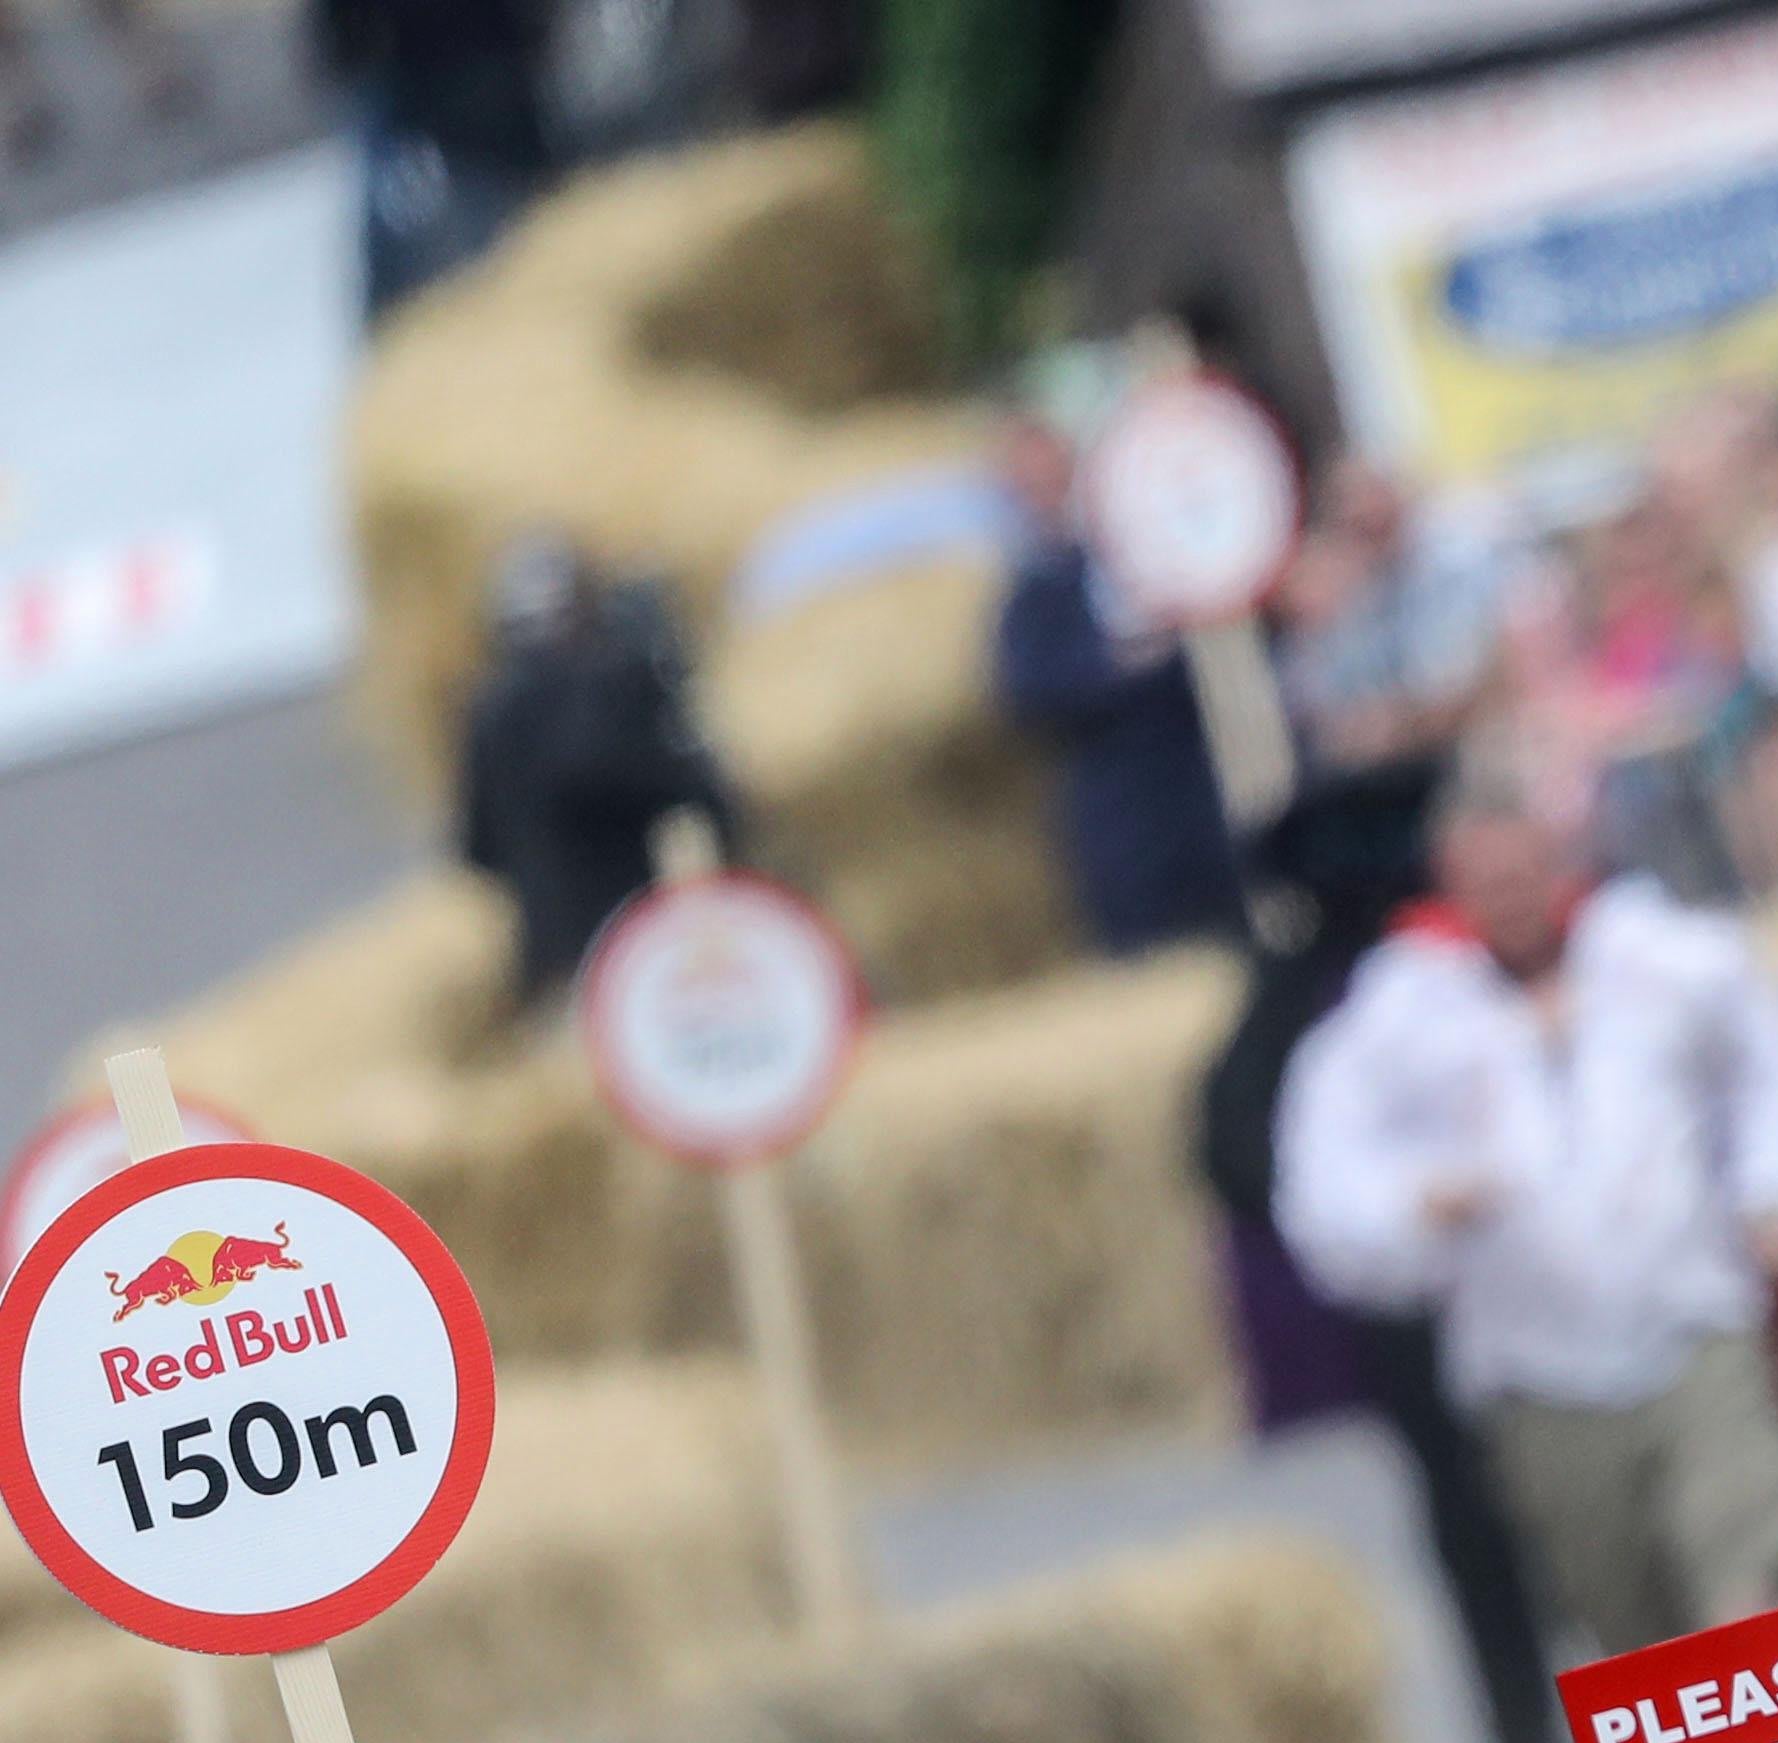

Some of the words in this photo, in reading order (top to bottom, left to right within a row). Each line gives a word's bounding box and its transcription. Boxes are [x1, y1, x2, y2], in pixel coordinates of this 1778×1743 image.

[99, 1318, 225, 1403] Red
[226, 1282, 348, 1368] Bull
[97, 1394, 418, 1533] 150m
